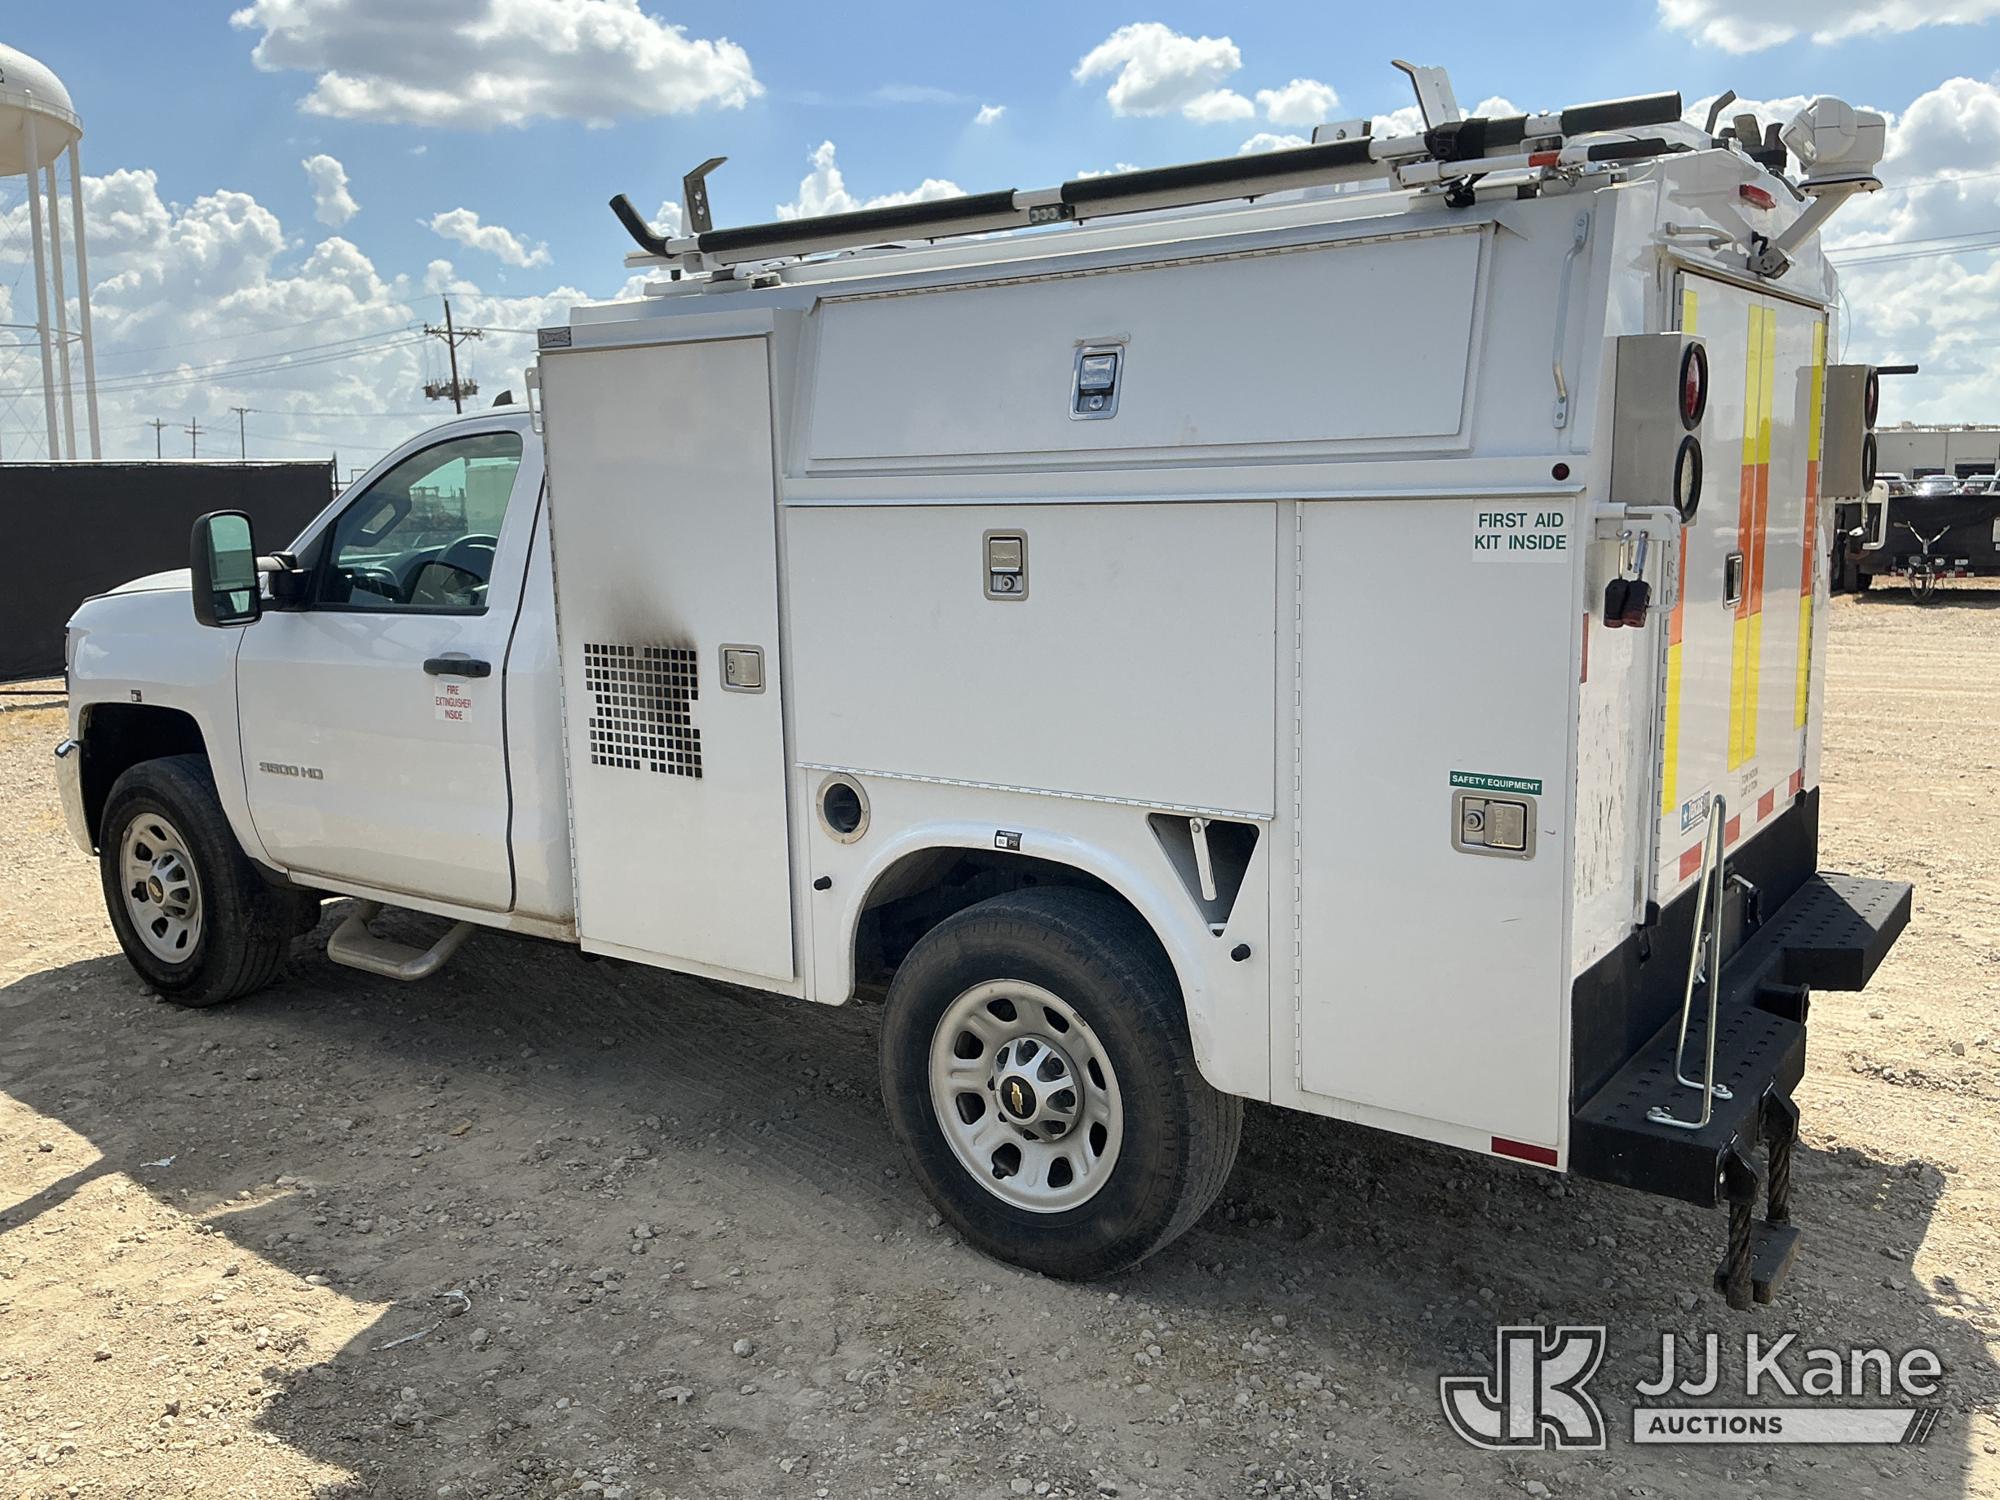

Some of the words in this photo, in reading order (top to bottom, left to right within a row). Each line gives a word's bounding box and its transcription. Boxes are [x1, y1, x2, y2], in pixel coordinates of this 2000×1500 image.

[1478, 512, 1528, 528] FIRST
[1534, 512, 1564, 528] AID
[1474, 534, 1501, 550] KIT
[1508, 534, 1567, 550] INSIDE
[446, 684, 460, 695] FIRE
[435, 696, 472, 709] EXTINGUISHER
[444, 709, 463, 720] INSIDE
[300, 766, 324, 780] HD
[1451, 774, 1486, 786] SAFETY
[1487, 778, 1540, 791] EQUIPMENT
